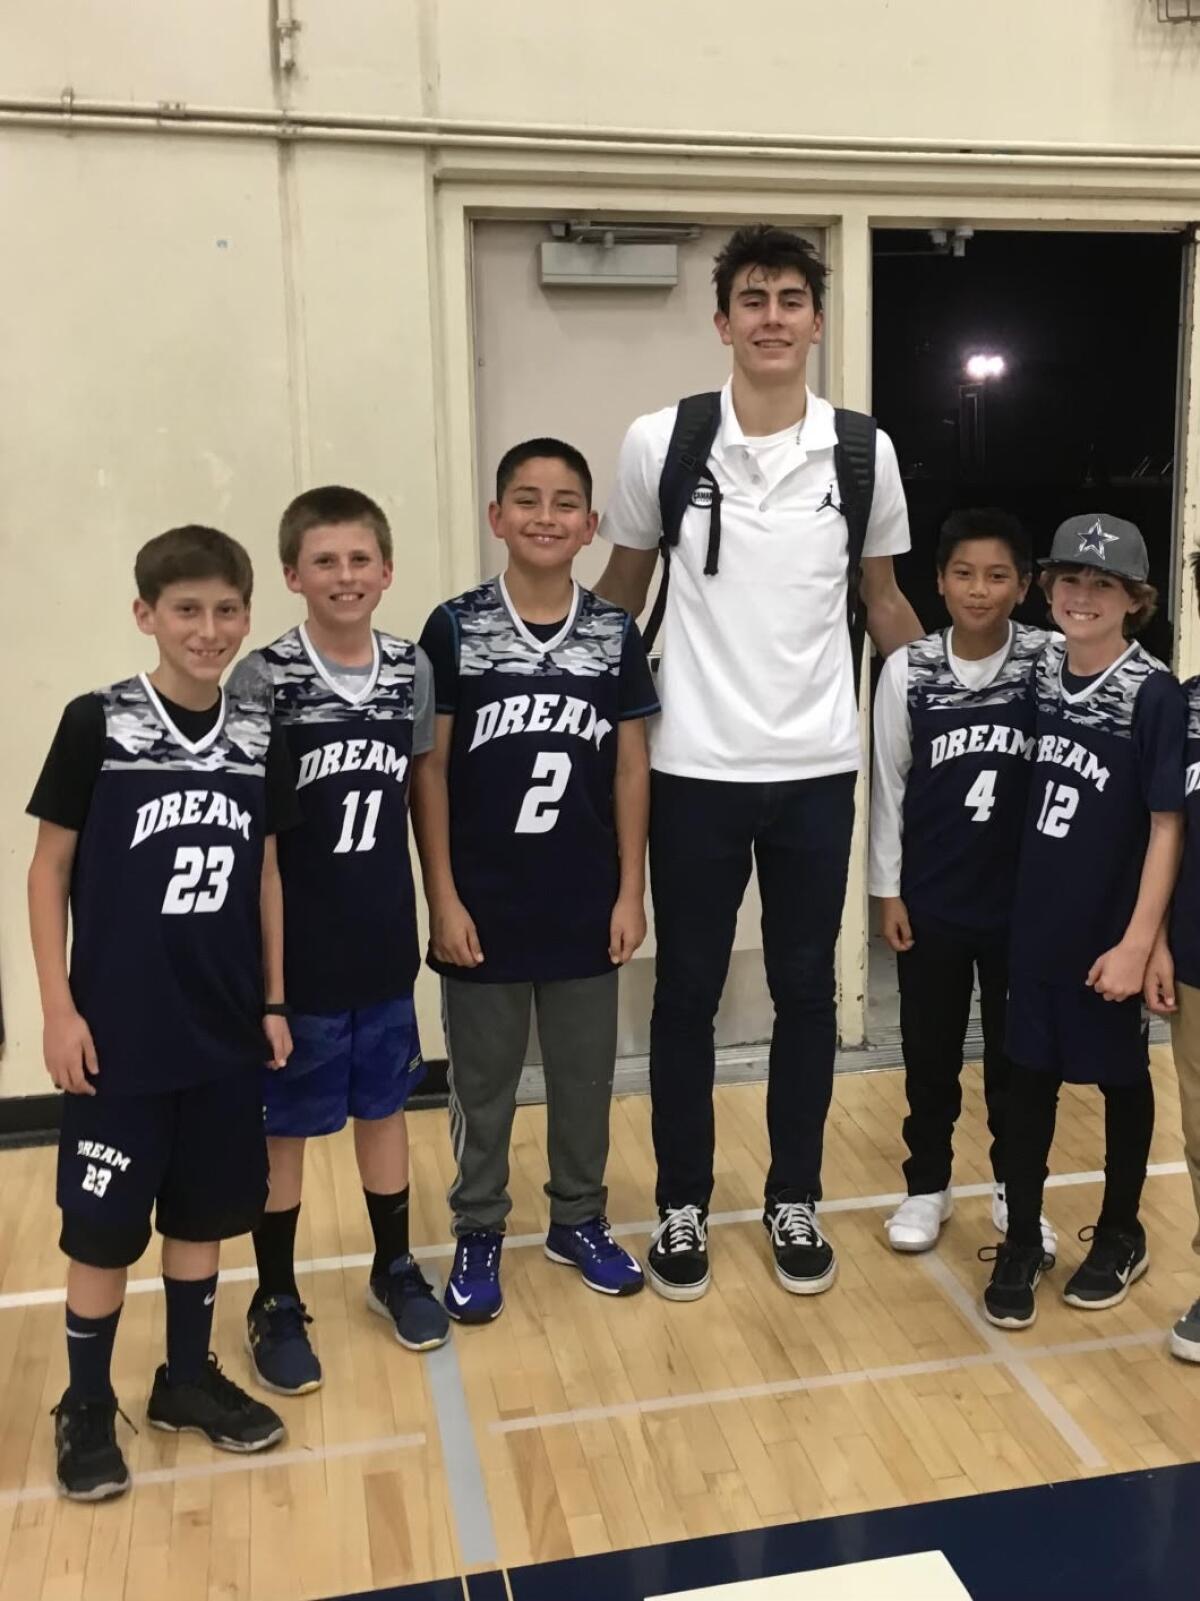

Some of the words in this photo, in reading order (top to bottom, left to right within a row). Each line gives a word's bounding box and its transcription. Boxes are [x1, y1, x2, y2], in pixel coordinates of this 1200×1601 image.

[468, 693, 613, 752] DREAM
[931, 725, 1036, 769] DREAM
[296, 739, 408, 790] DREAM
[514, 752, 572, 833] 2
[1036, 735, 1110, 792] REAM
[129, 789, 252, 849] DREAM
[333, 789, 383, 853] 11
[964, 770, 998, 821] 4
[1036, 780, 1079, 838] 12
[161, 846, 235, 914] 23
[82, 1163, 112, 1198] 23
